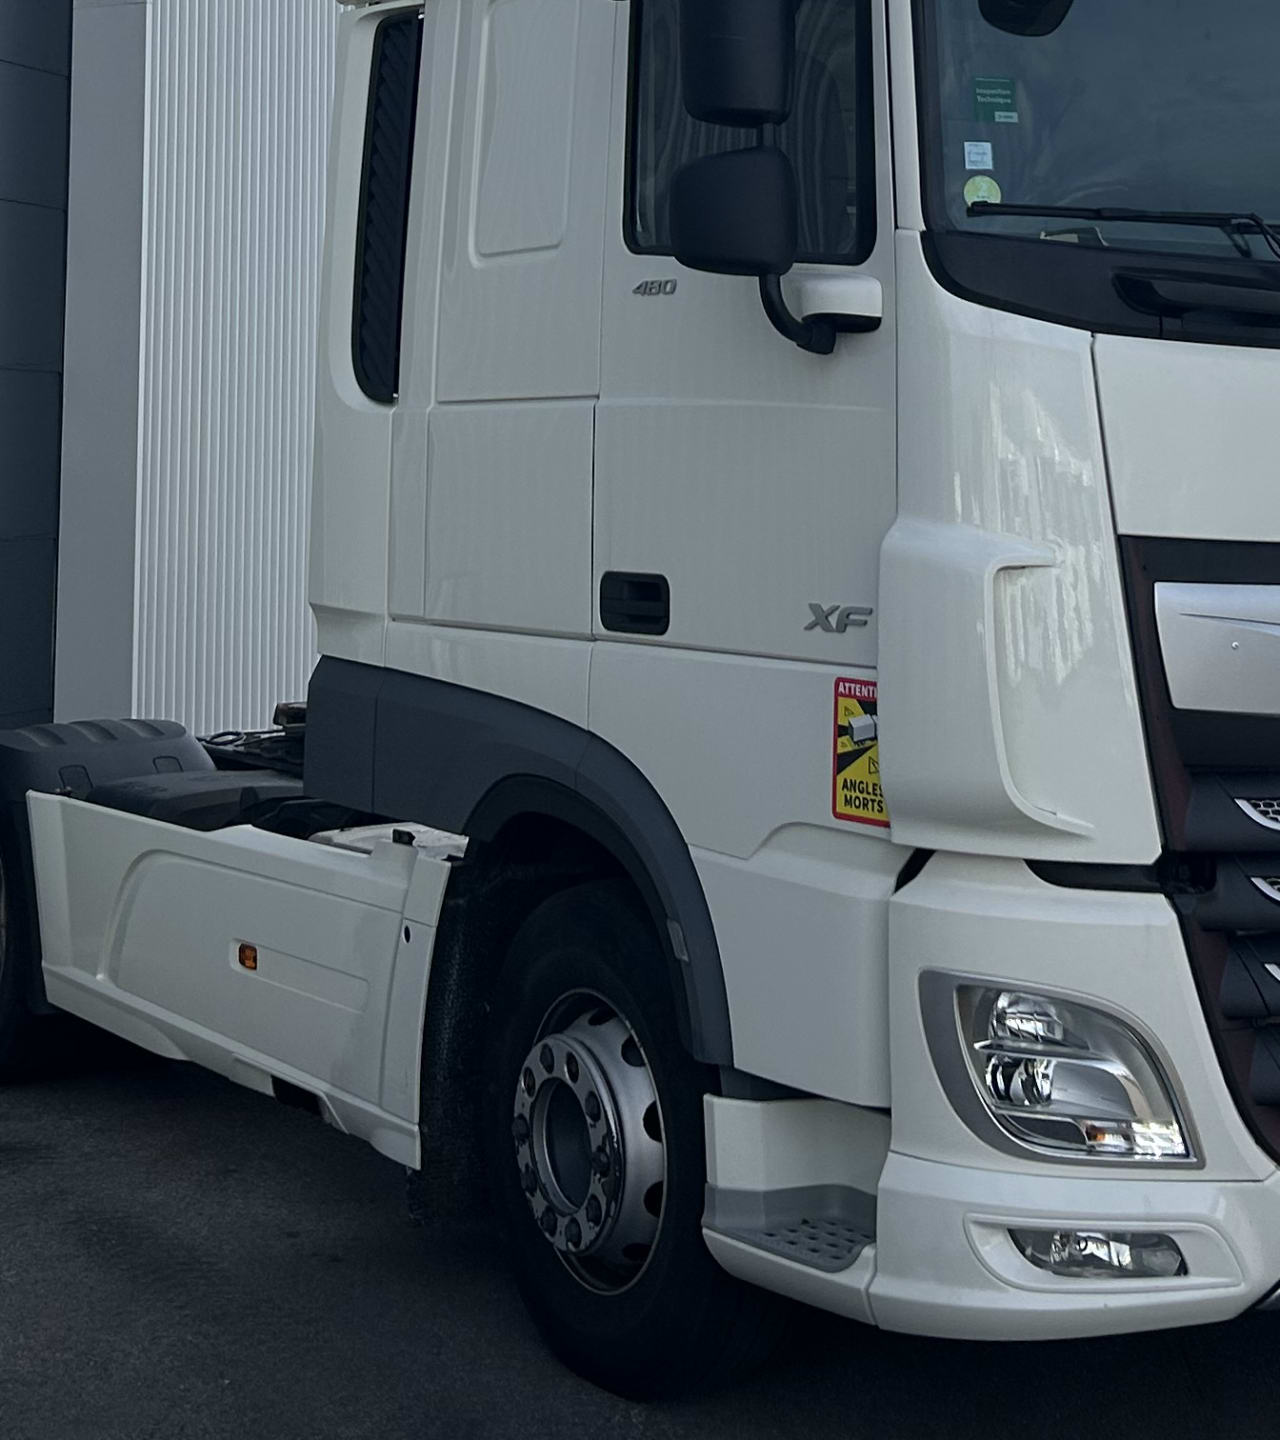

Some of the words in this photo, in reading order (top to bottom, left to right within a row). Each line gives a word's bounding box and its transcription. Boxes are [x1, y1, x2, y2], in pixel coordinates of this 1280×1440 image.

[631, 278, 677, 296] 480
[803, 602, 873, 633] XF
[838, 681, 878, 699] ATTENTI
[843, 793, 884, 814] MORTS
